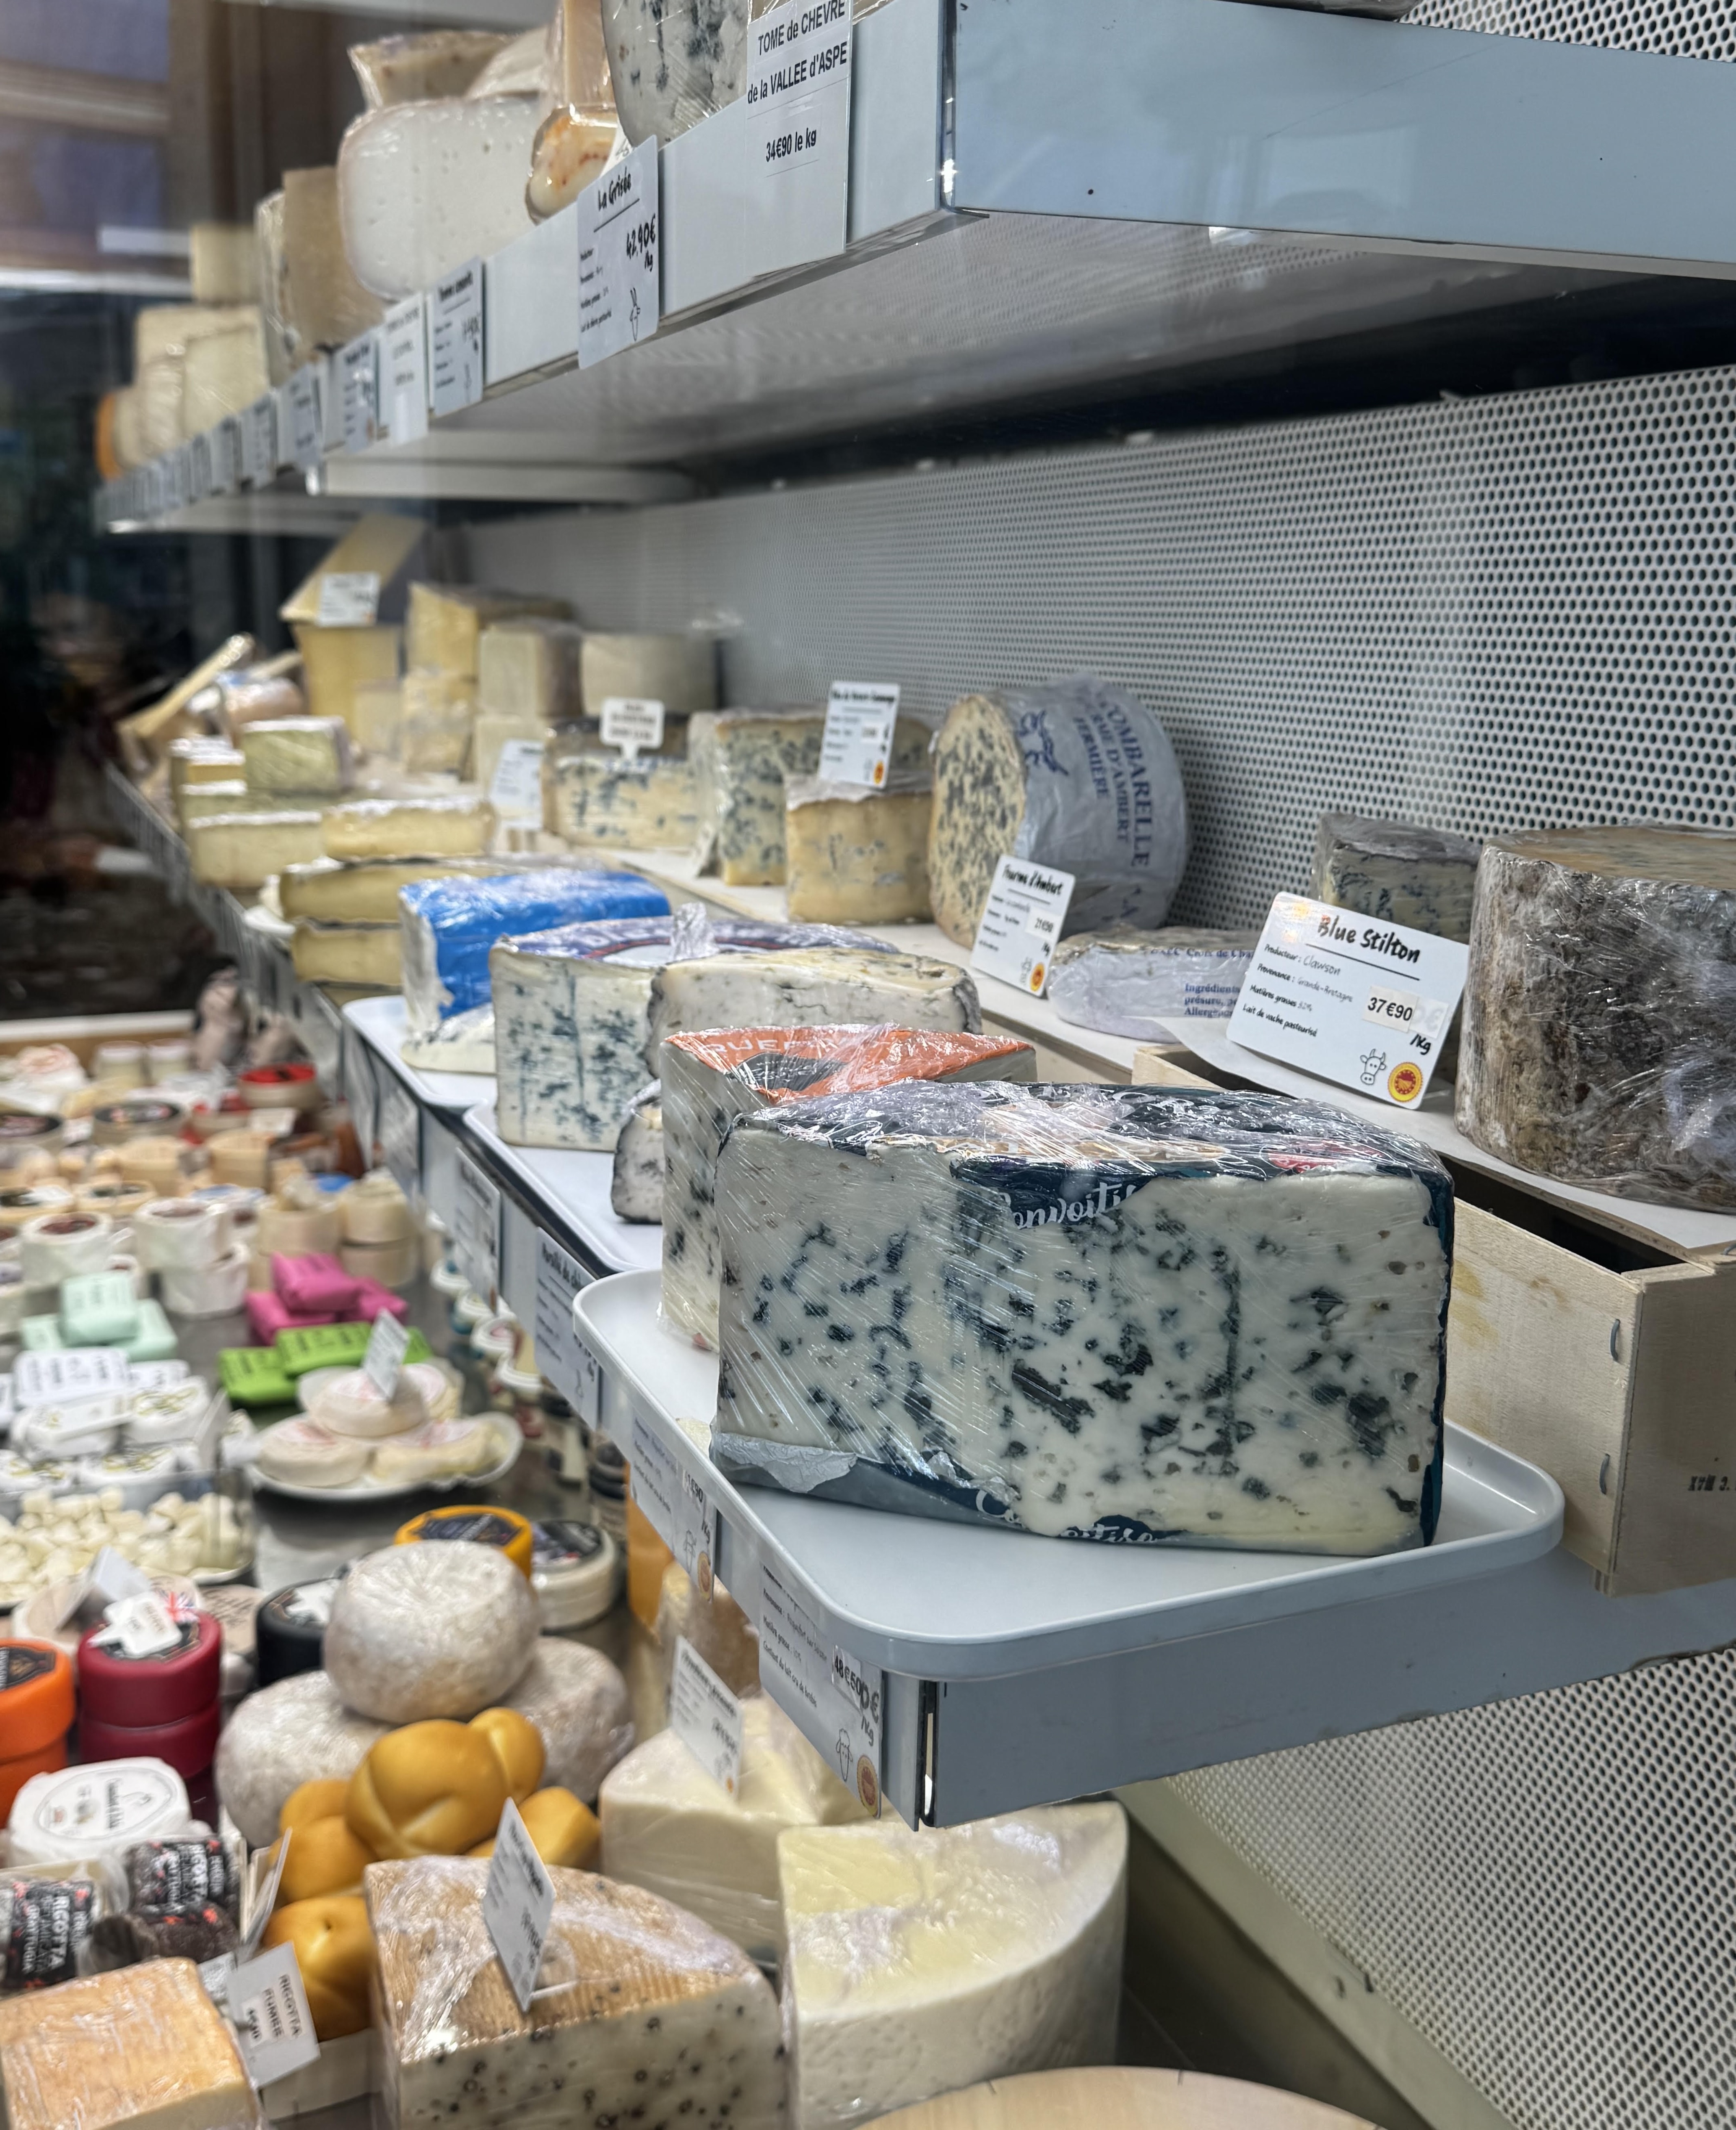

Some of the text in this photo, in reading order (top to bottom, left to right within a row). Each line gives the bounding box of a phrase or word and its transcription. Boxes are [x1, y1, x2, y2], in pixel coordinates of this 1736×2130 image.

[758, 0, 845, 56] TOME de CHEVRE
[748, 41, 847, 104] de la VALLEE d'ASPE
[766, 127, 816, 163] 34€90 le kg
[598, 190, 607, 212] La
[1217, 949, 1229, 958] de
[1317, 914, 1421, 963] Blue Stilton
[1303, 955, 1341, 976] Clawson
[1243, 1003, 1256, 1014] Lait
[1256, 1008, 1265, 1018] de
[1265, 1014, 1283, 1025] vache
[1367, 997, 1413, 1021] 37€90
[834, 1655, 861, 1696] 48€50
[278, 1974, 302, 2039] RICOTTA
